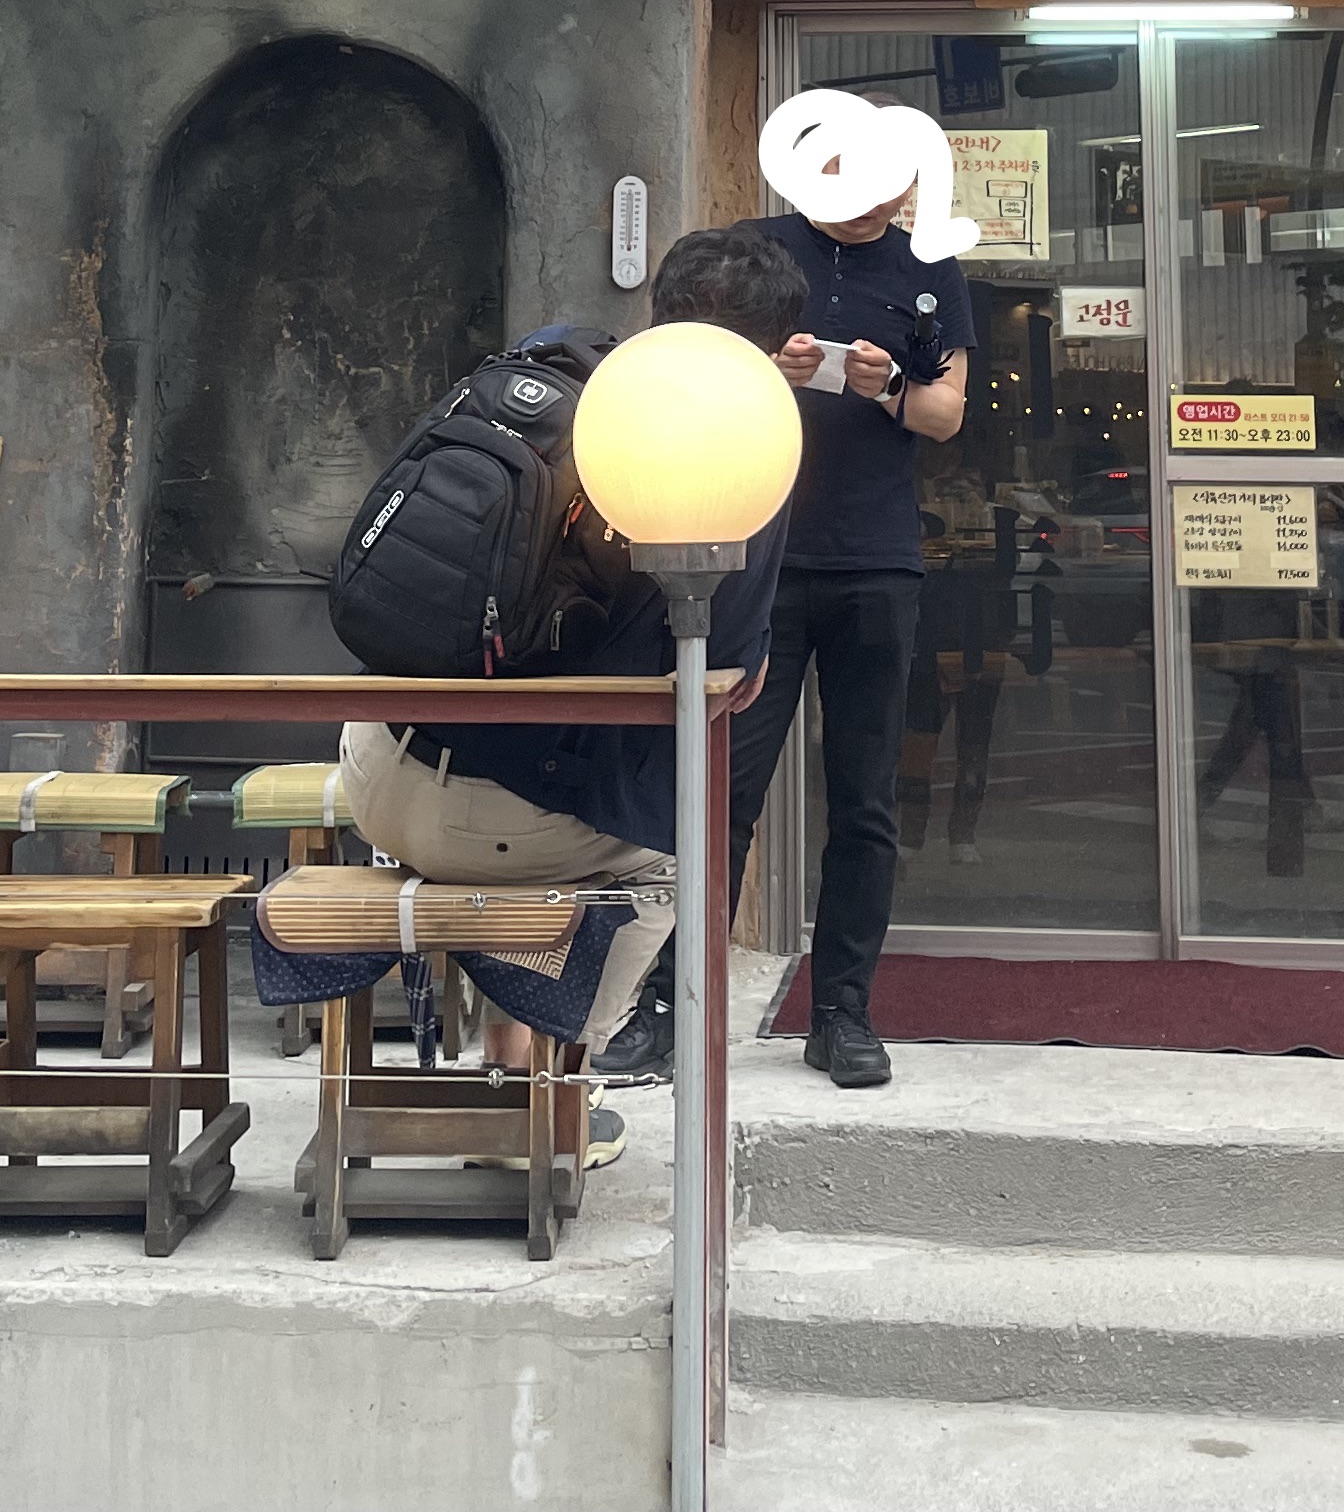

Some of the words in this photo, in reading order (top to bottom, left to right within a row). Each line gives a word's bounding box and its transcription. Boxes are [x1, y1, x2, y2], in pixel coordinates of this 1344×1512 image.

[1076, 299, 1133, 327] 고정문
[1182, 404, 1236, 419] 영업시간
[1179, 428, 1203, 442] 오전
[1276, 429, 1311, 442] 23:00
